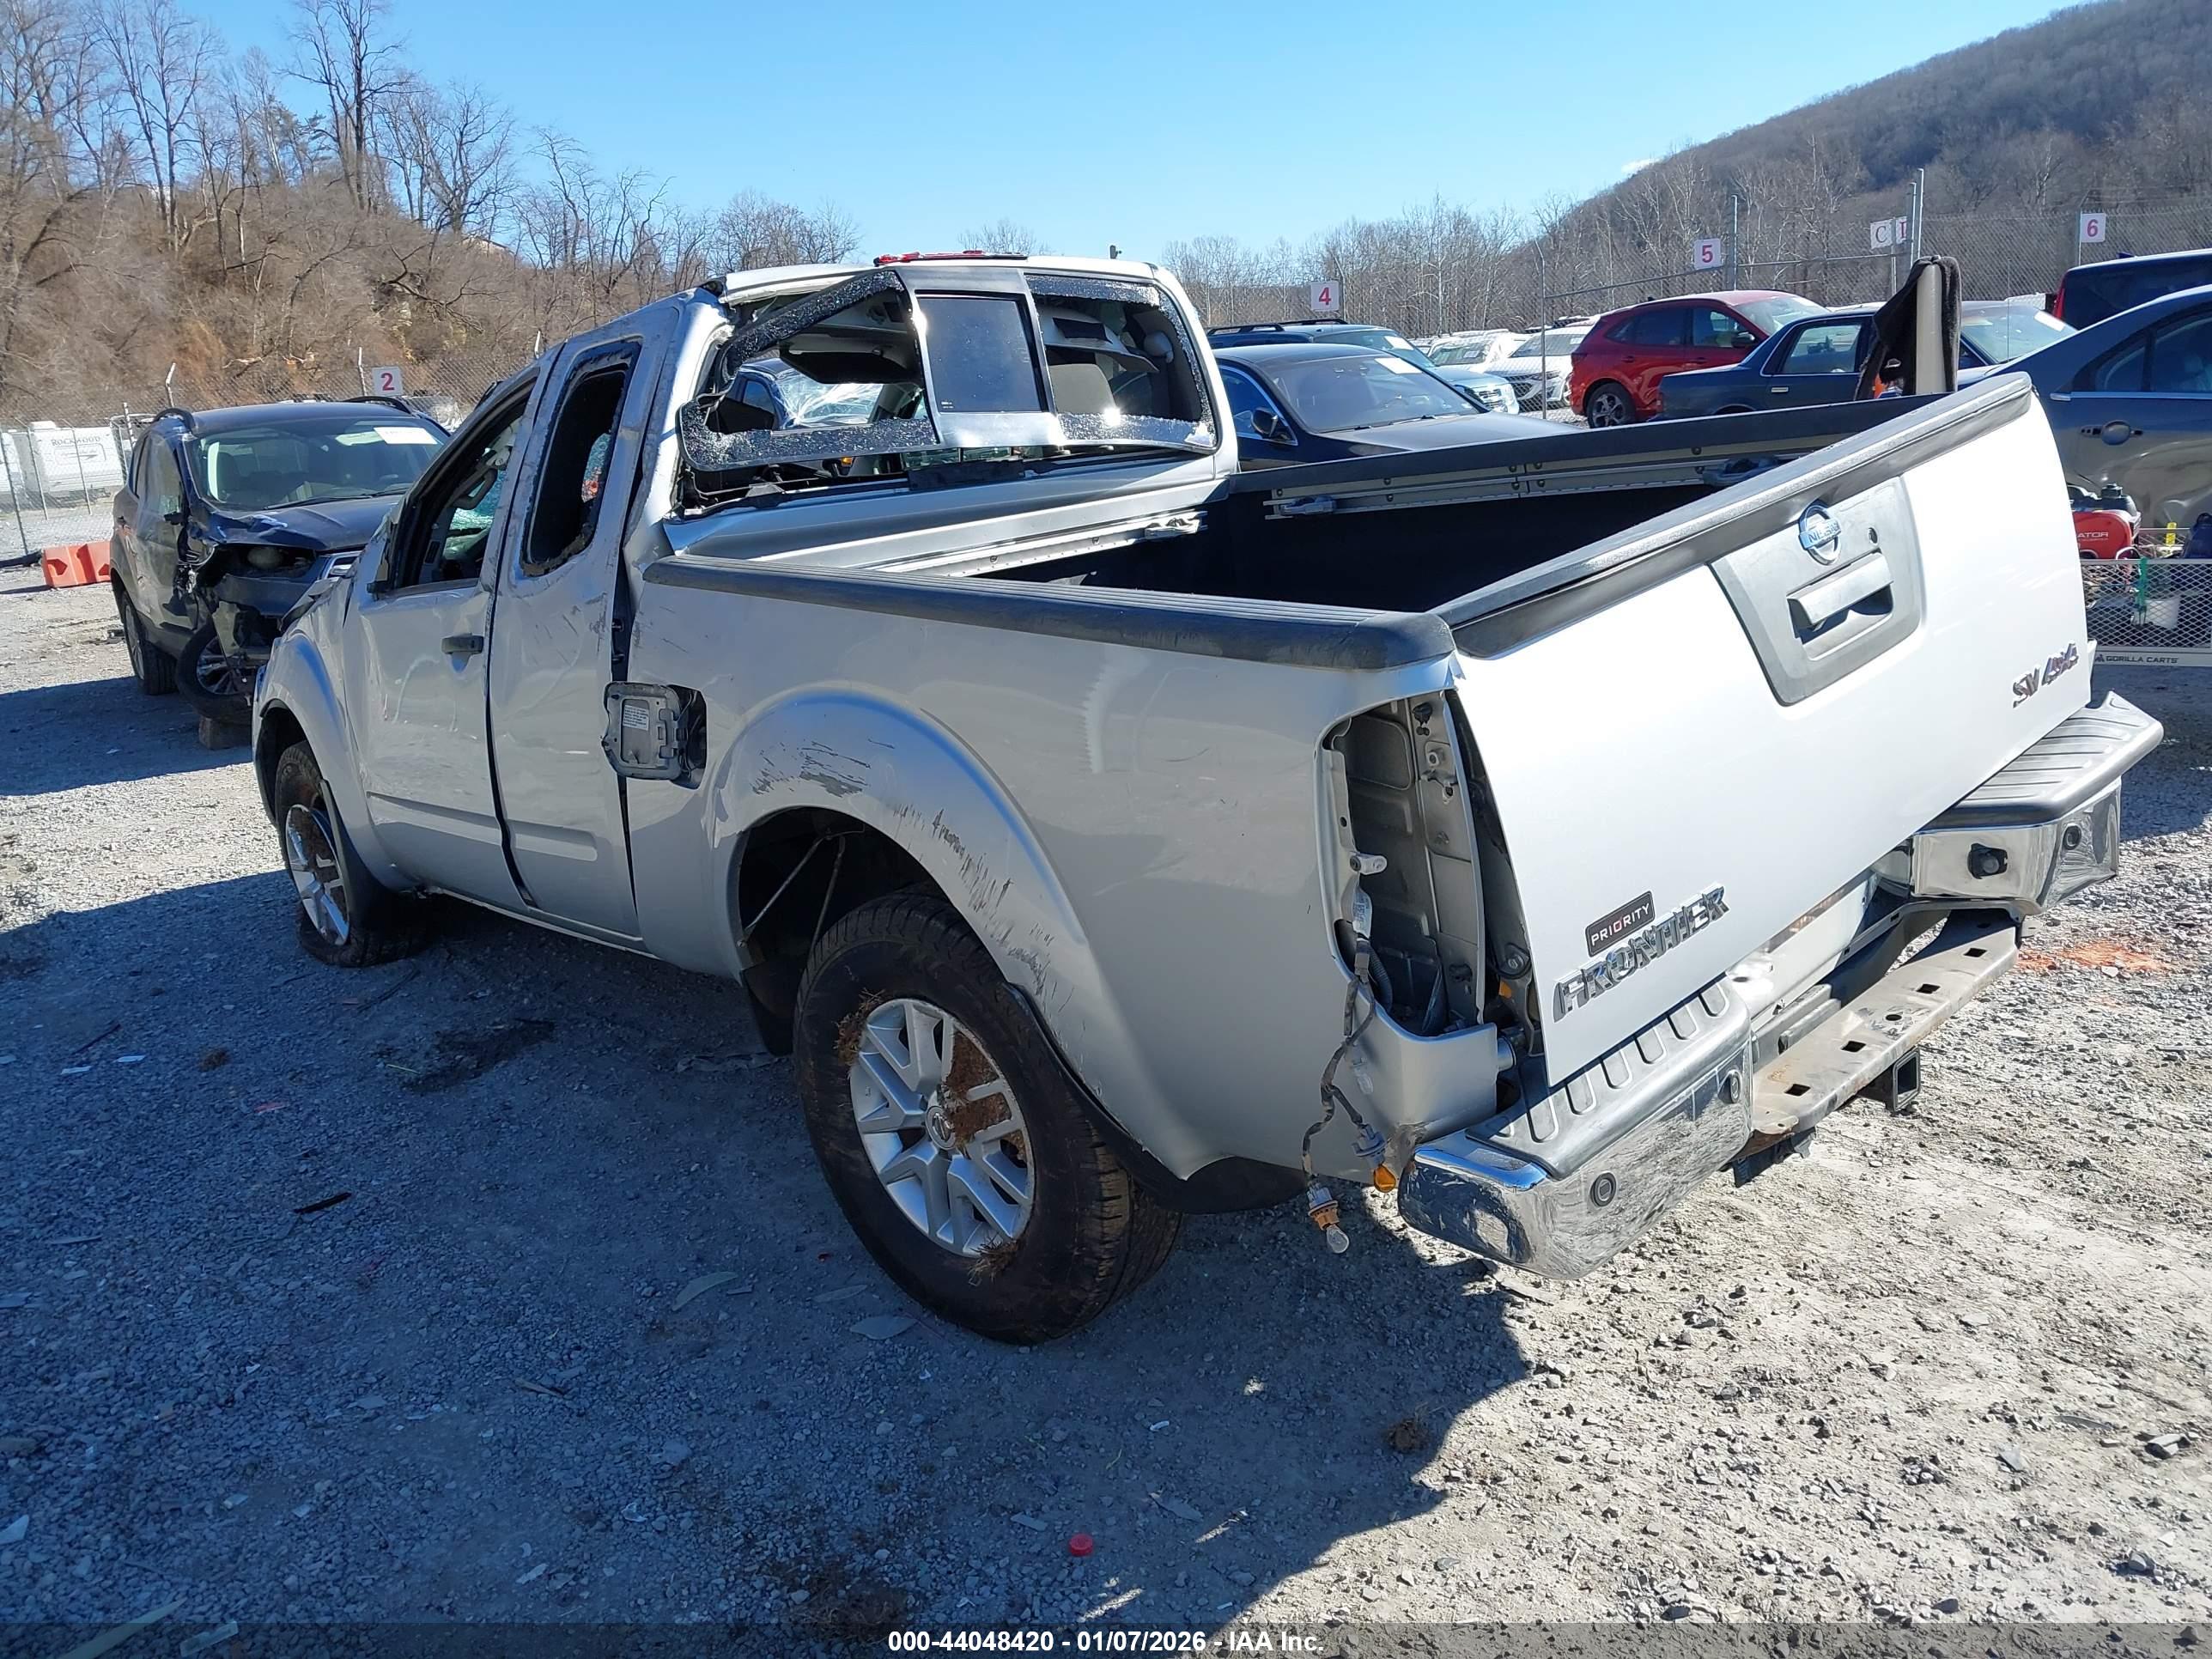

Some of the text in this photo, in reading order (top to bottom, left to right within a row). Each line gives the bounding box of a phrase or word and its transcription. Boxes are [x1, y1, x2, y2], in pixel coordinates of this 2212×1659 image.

[1875, 225, 1887, 243] C
[2087, 219, 2099, 237] 6
[1702, 245, 1713, 263] 5
[1318, 287, 1332, 306] 4
[380, 372, 395, 391] 2
[1590, 902, 1650, 946] PRIORITY
[1553, 884, 1730, 1023] FRONTIER
